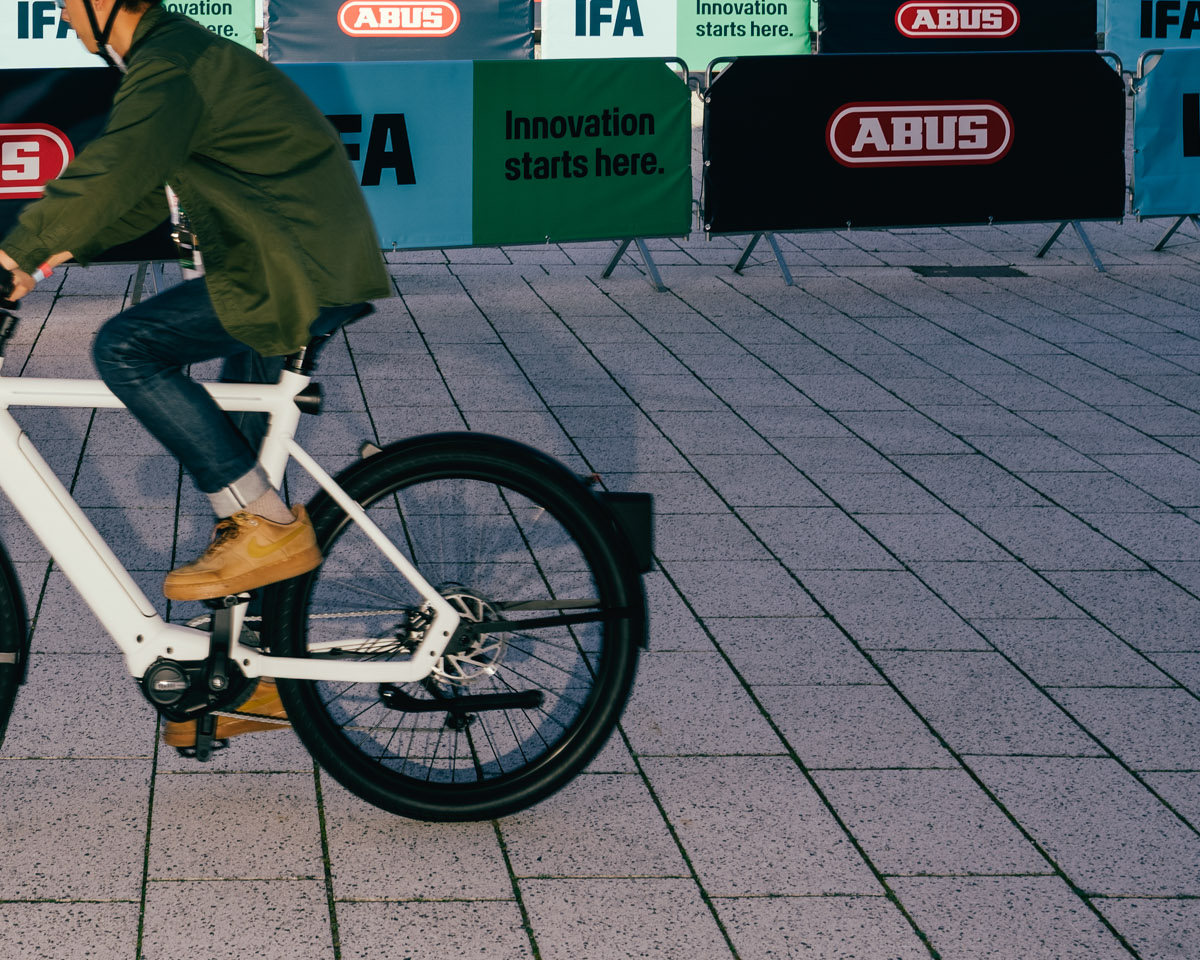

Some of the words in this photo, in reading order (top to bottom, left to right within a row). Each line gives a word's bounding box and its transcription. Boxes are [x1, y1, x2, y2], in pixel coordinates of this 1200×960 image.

[164, 0, 232, 16] ovation
[353, 7, 443, 29] ABUS
[695, 22, 747, 38] starts
[750, 20, 794, 38] here.
[911, 9, 1003, 30] ABUS
[505, 107, 655, 140] Innovation
[851, 115, 988, 152] ABUS
[504, 151, 589, 181] starts
[595, 147, 665, 177] here.
